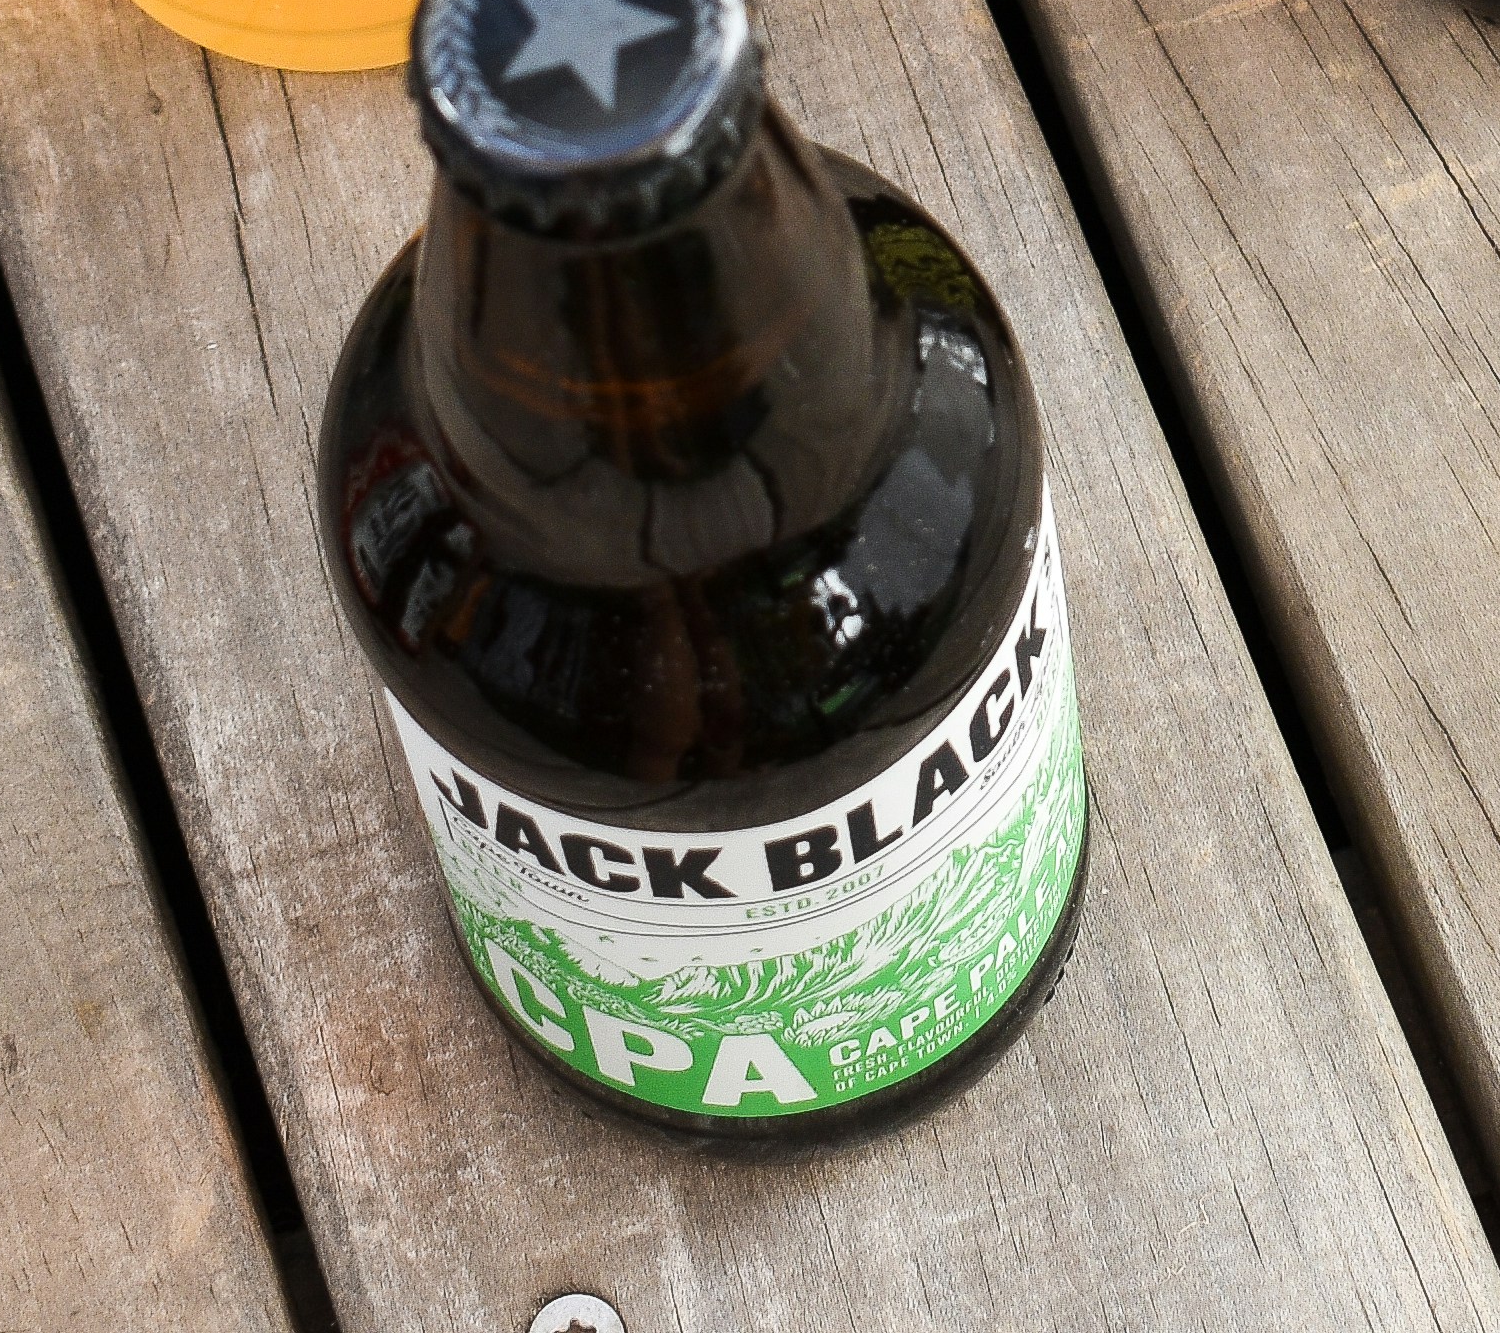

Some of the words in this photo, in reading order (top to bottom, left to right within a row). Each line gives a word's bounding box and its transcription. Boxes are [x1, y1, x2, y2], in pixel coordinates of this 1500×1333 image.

[429, 766, 738, 900] JACK
[744, 892, 822, 921] ESTD.
[827, 864, 886, 900] 2007
[483, 938, 818, 1108] CPA
[828, 984, 962, 1067] CAPE
[834, 1076, 855, 1093] OF
[864, 1055, 910, 1083] CAPE
